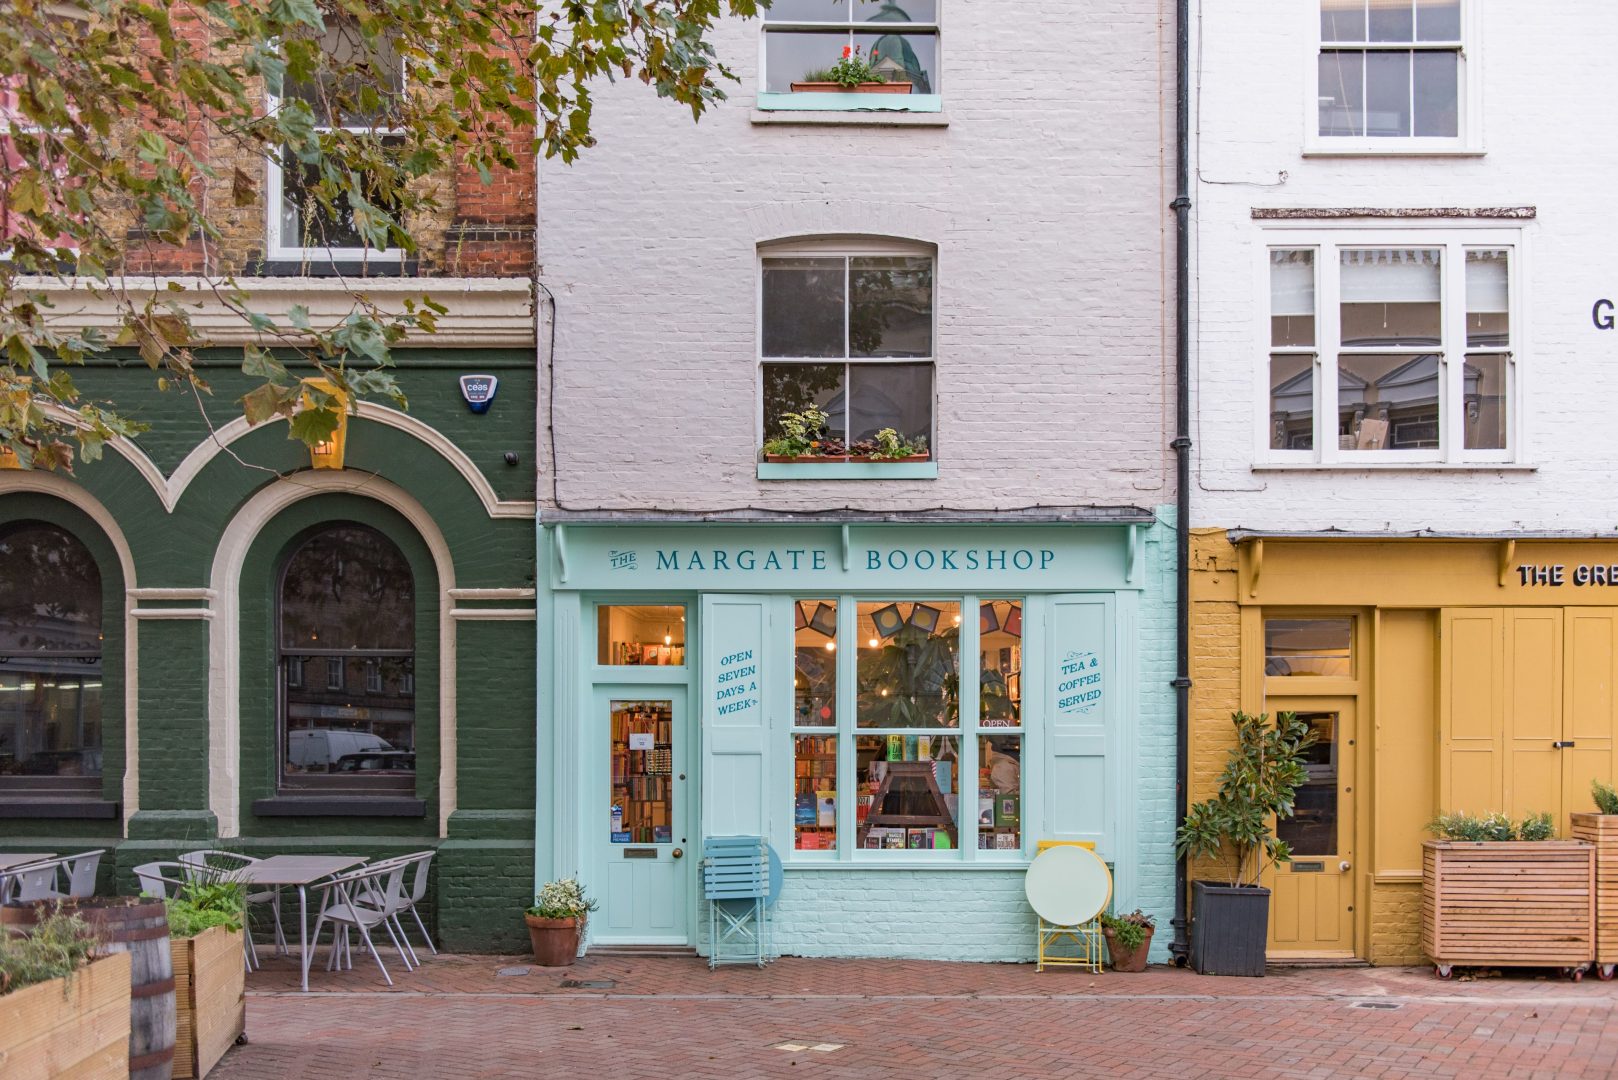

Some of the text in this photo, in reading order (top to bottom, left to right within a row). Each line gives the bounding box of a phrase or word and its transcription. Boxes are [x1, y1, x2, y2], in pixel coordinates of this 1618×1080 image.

[610, 549, 1055, 570] THE MARGATE BOOKSHOP
[1516, 564, 1566, 587] THE
[720, 649, 753, 666] OPEN
[1061, 657, 1099, 675] TEA &
[718, 665, 756, 683] SEVEN
[1058, 672, 1101, 692] COFFEE
[716, 681, 757, 700] DAYS A
[1058, 689, 1102, 709] SERVED
[717, 698, 752, 716] WEEK
[982, 719, 1010, 727] OPEN
